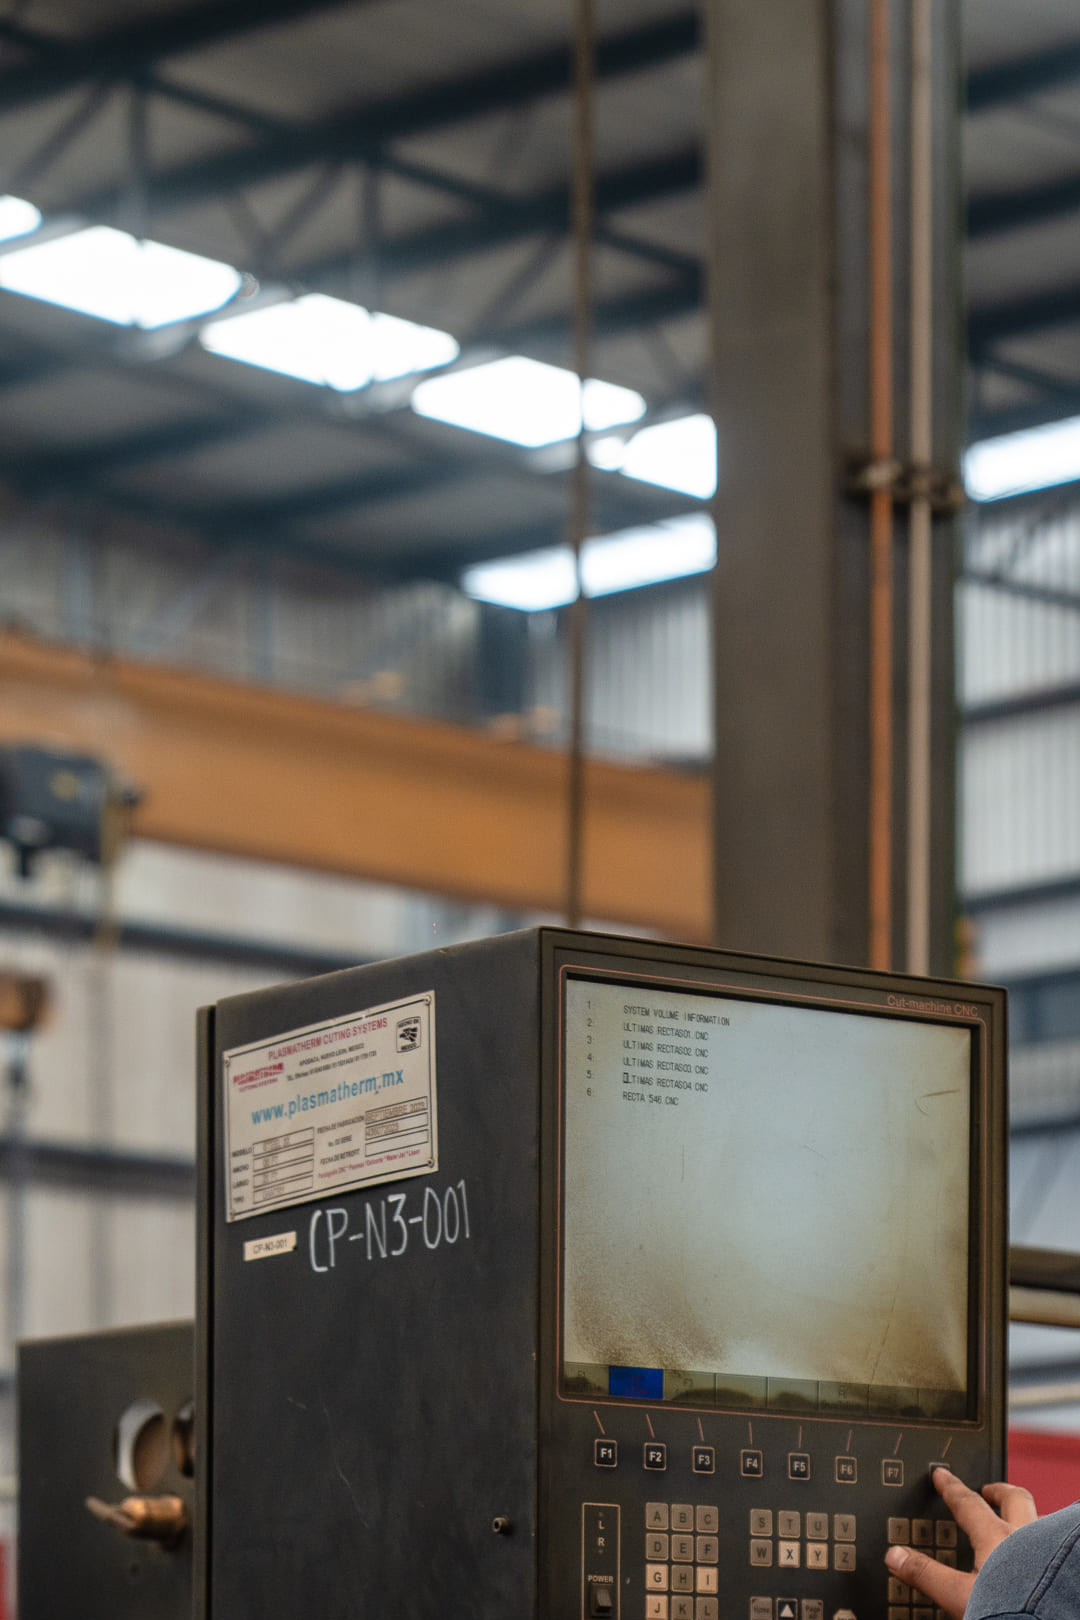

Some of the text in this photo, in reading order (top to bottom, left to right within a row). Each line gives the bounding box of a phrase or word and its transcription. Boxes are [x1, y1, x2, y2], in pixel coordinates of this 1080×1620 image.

[624, 1005, 650, 1016] SYSTEM
[653, 1009, 679, 1020] VOLUME
[684, 1012, 730, 1026] INFORMATION
[954, 1003, 979, 1017] CNC
[624, 1023, 654, 1034] ULTIMAS
[268, 1017, 388, 1060] PLASMATHERM CUTING SYSTEMS
[623, 1040, 654, 1051] ULTIMAS
[623, 1058, 653, 1069] ULTIMAS
[251, 1069, 404, 1125] www.plasmatherm.mx
[623, 1091, 645, 1102] RECTA
[309, 1179, 470, 1272] CP-N3-001
[600, 1447, 613, 1459] F1
[649, 1451, 662, 1463] F2
[698, 1454, 711, 1466] F3
[746, 1458, 758, 1469] F4
[793, 1460, 806, 1472] F5
[840, 1463, 853, 1475] F6
[887, 1467, 899, 1479] F7
[653, 1511, 661, 1522] A
[679, 1513, 687, 1523] B
[703, 1514, 712, 1525] C
[758, 1517, 766, 1528] S
[786, 1519, 793, 1529] T
[814, 1520, 822, 1531] U
[841, 1522, 849, 1533] V
[654, 1541, 662, 1552] D
[679, 1543, 687, 1553] E
[704, 1543, 711, 1555] F
[756, 1547, 767, 1558] W
[786, 1549, 793, 1560] X
[814, 1551, 822, 1561] Y
[841, 1552, 849, 1563] Z
[587, 1574, 614, 1583] POWER
[654, 1572, 662, 1583] G
[679, 1573, 687, 1584] H
[654, 1603, 661, 1614] J
[679, 1604, 687, 1615] K
[704, 1605, 711, 1616] L
